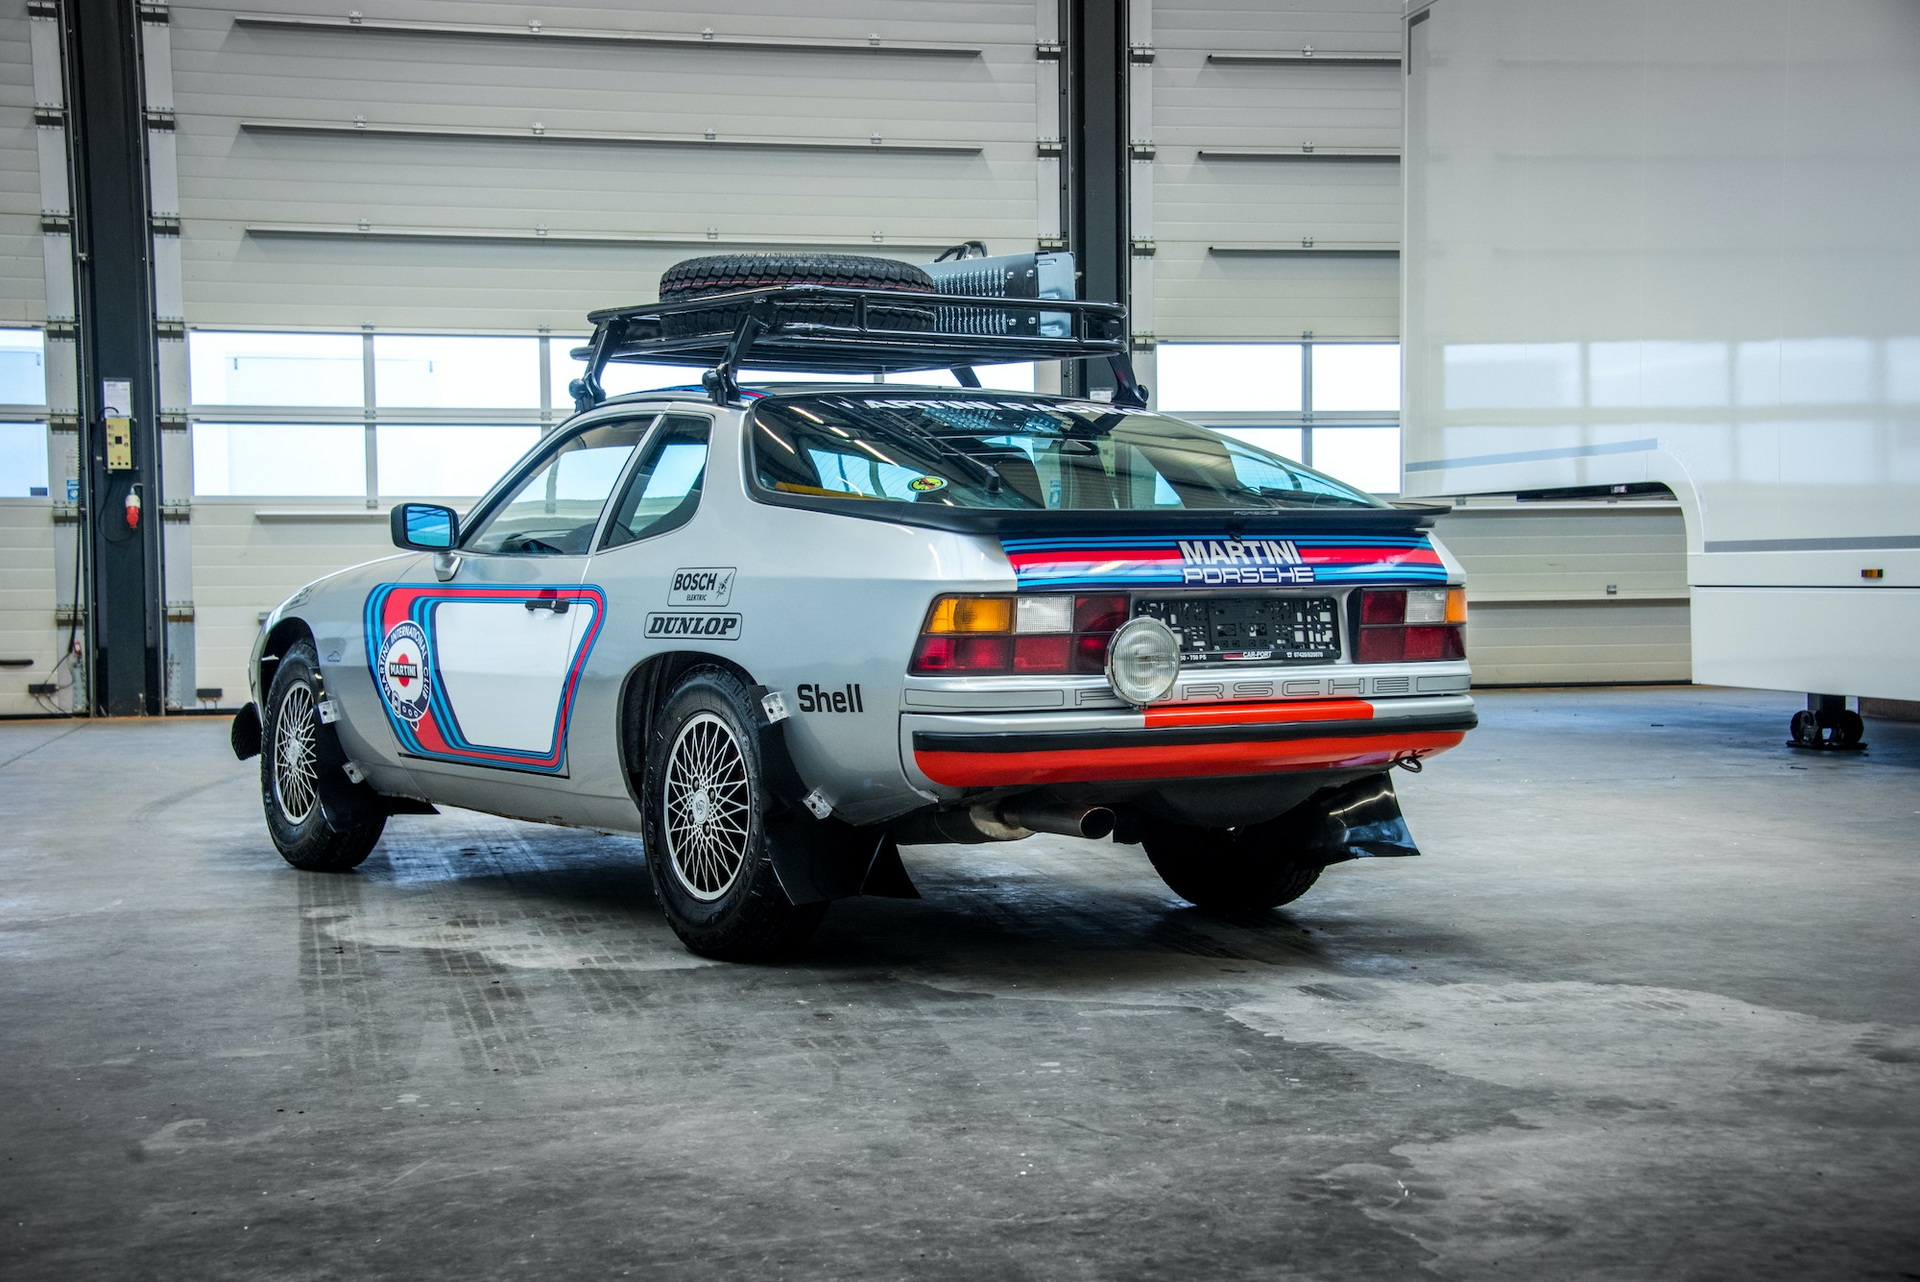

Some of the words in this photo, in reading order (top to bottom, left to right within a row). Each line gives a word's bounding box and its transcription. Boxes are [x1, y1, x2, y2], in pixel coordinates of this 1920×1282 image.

[1177, 540, 1303, 565] MARTINI
[673, 573, 717, 591] BOSCH
[1182, 566, 1315, 584] PORSCHE
[648, 616, 738, 636] DUNLOP
[379, 641, 392, 698] MARTINI
[390, 624, 429, 660] INTERNATIONAL
[1242, 650, 1272, 659] CAR-PORT
[390, 664, 417, 677] MARTINI
[797, 683, 864, 713] Shell
[1075, 676, 1409, 706] PRSCHE
